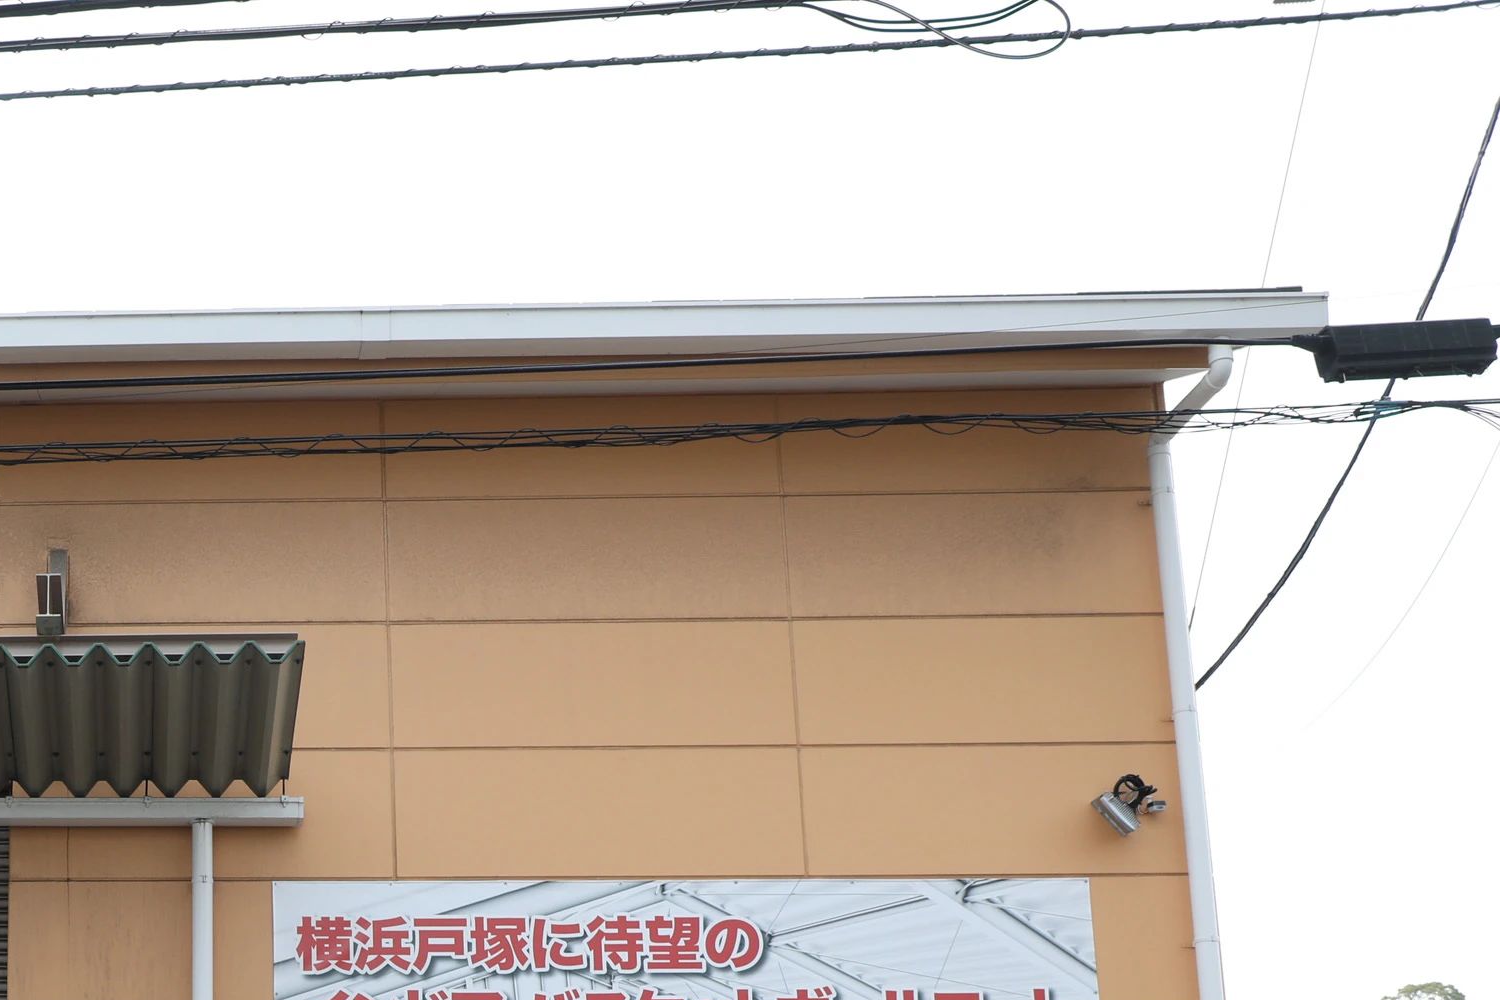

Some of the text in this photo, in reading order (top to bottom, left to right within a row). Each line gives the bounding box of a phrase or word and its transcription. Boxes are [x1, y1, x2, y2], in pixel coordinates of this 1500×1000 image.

[297, 915, 761, 972] 横浜戸塚に待望の
